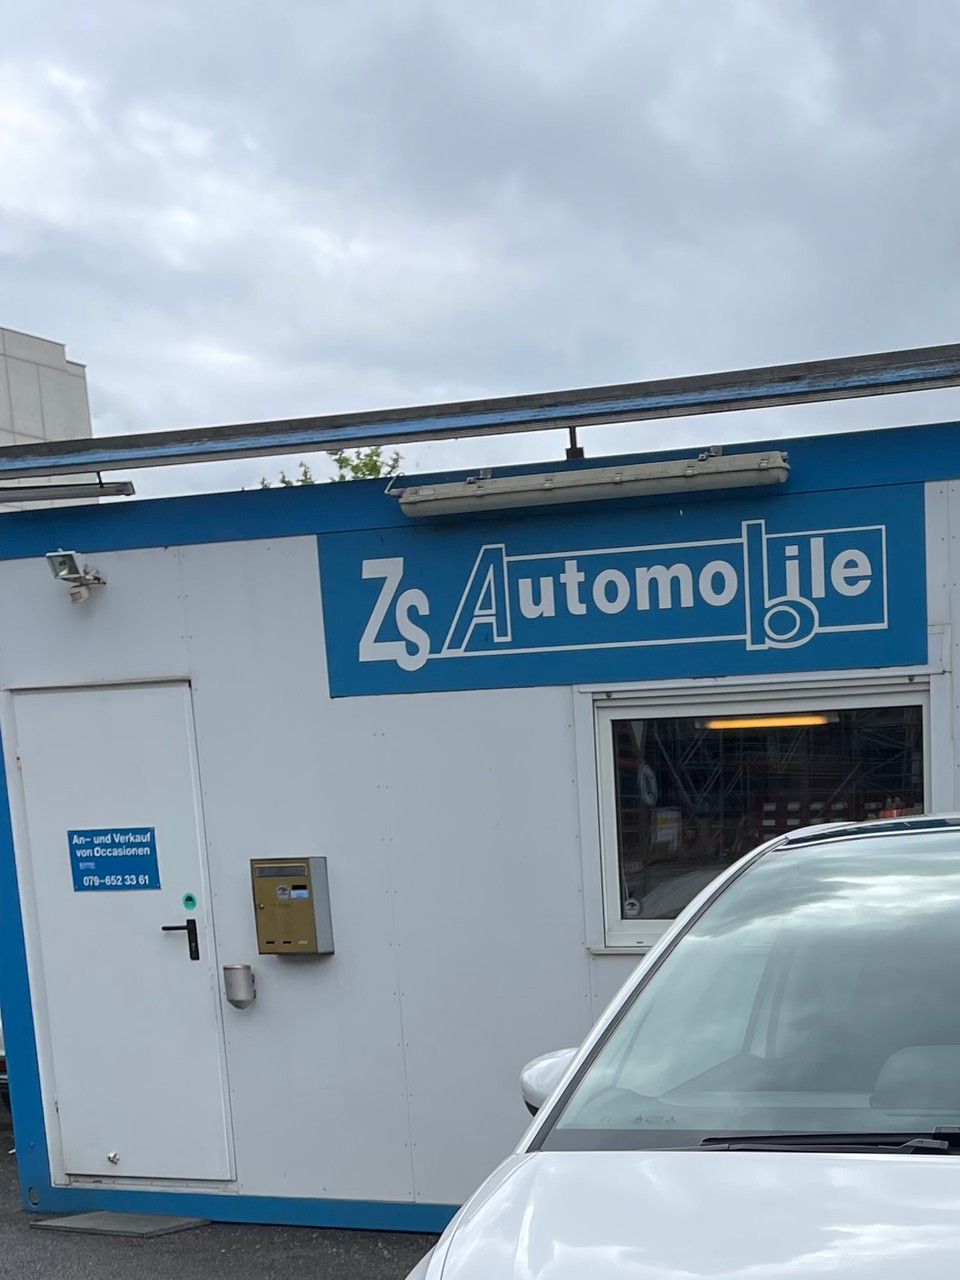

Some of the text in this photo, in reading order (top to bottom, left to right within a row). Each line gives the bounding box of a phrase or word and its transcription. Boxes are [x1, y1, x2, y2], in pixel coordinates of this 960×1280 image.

[441, 519, 874, 654] Automobile
[72, 832, 151, 844] An- und Verkauf
[76, 845, 150, 858] von Occasionen
[83, 874, 149, 886] 079-652 33 61
